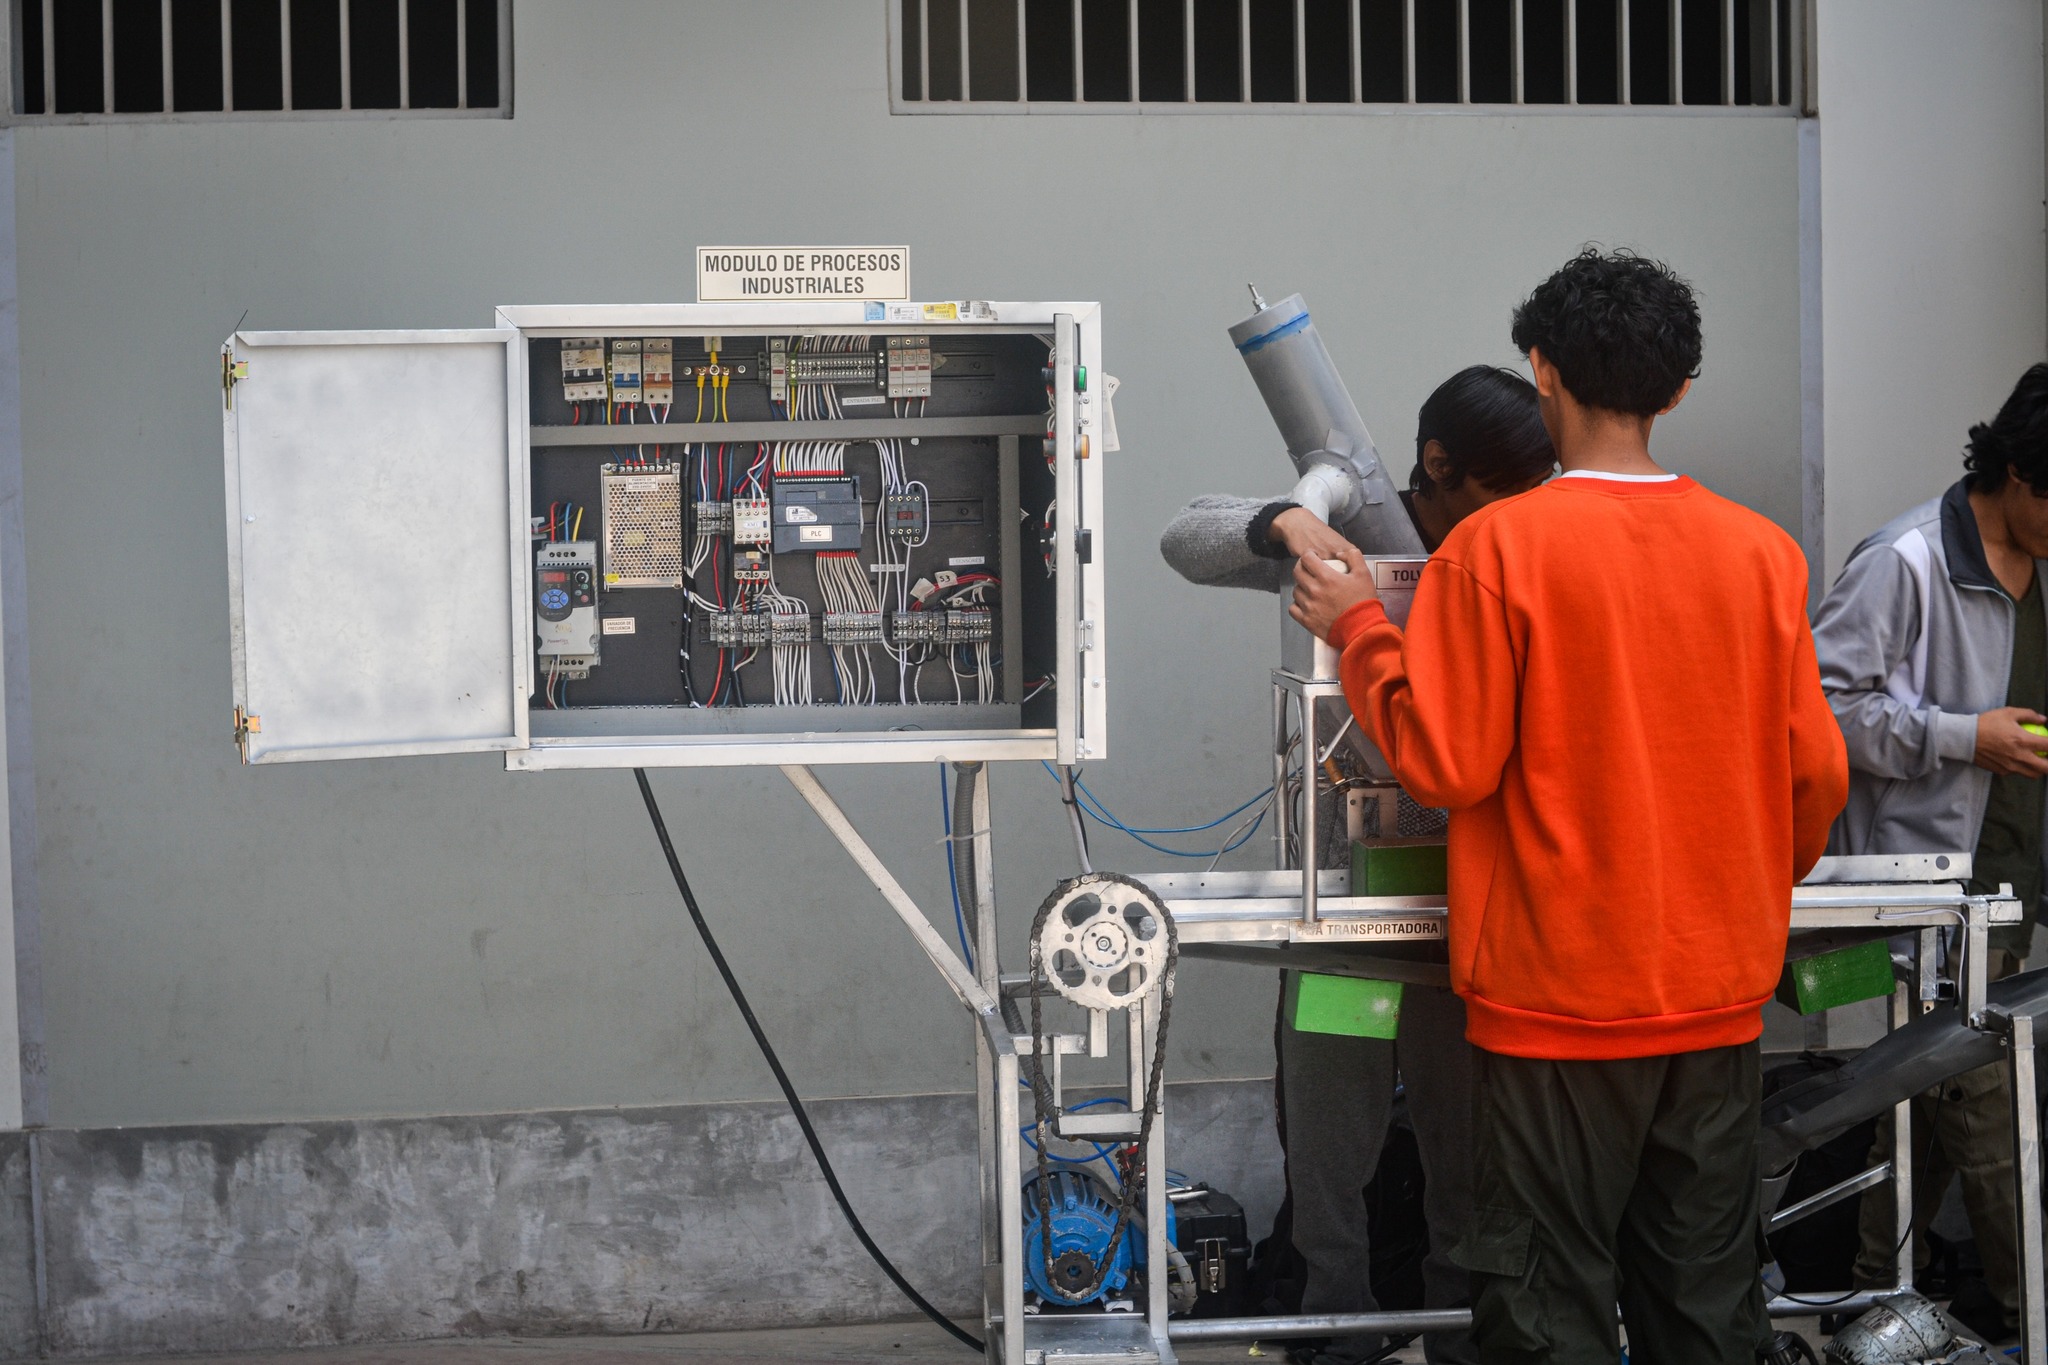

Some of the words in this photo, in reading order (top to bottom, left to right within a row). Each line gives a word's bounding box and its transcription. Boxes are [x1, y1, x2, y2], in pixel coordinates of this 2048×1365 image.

[705, 254, 778, 272] MODULO
[783, 254, 805, 272] DE
[811, 253, 901, 272] PROCESOS
[742, 276, 865, 294] INDUSTRIALES
[1327, 923, 1438, 936] TRANSPORTADORA
